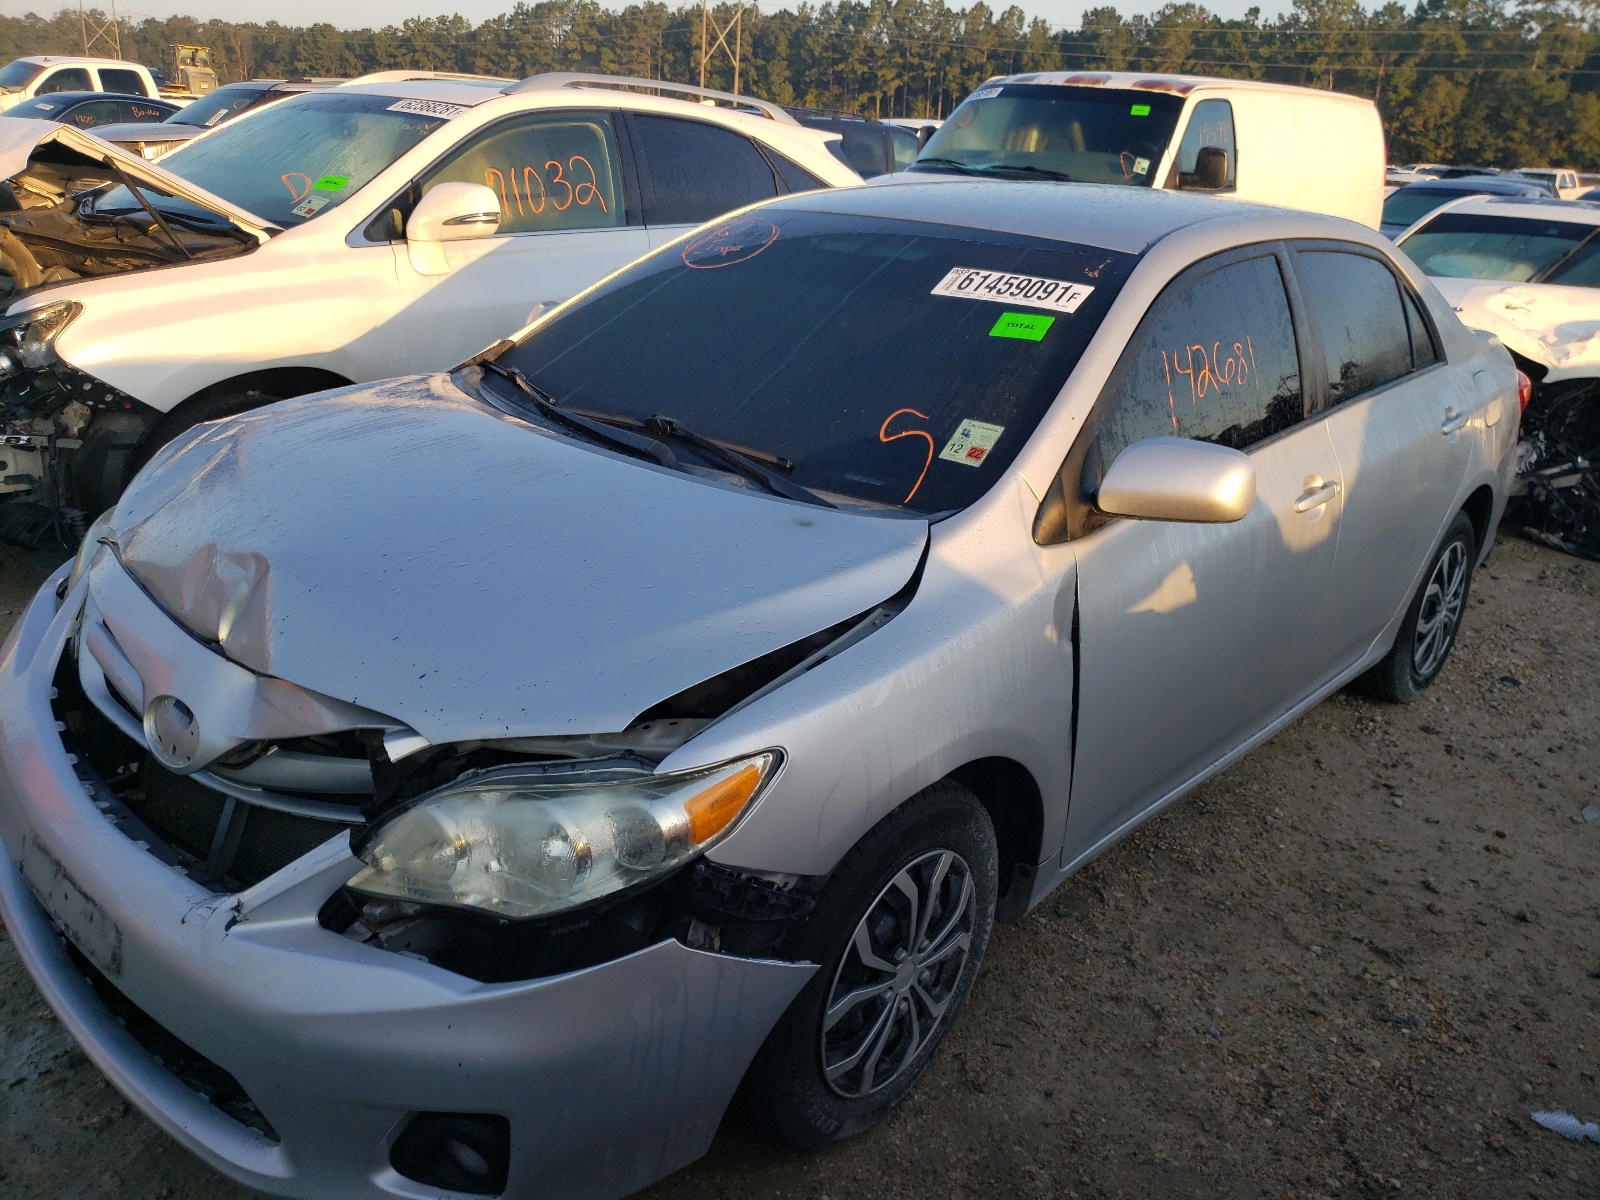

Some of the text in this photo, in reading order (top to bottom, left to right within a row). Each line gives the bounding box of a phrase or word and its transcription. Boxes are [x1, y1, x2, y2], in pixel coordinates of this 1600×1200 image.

[951, 267, 970, 276] INSP
[1007, 322, 1036, 330] TOTAL
[949, 442, 964, 454] 12
[967, 446, 985, 459] 22
